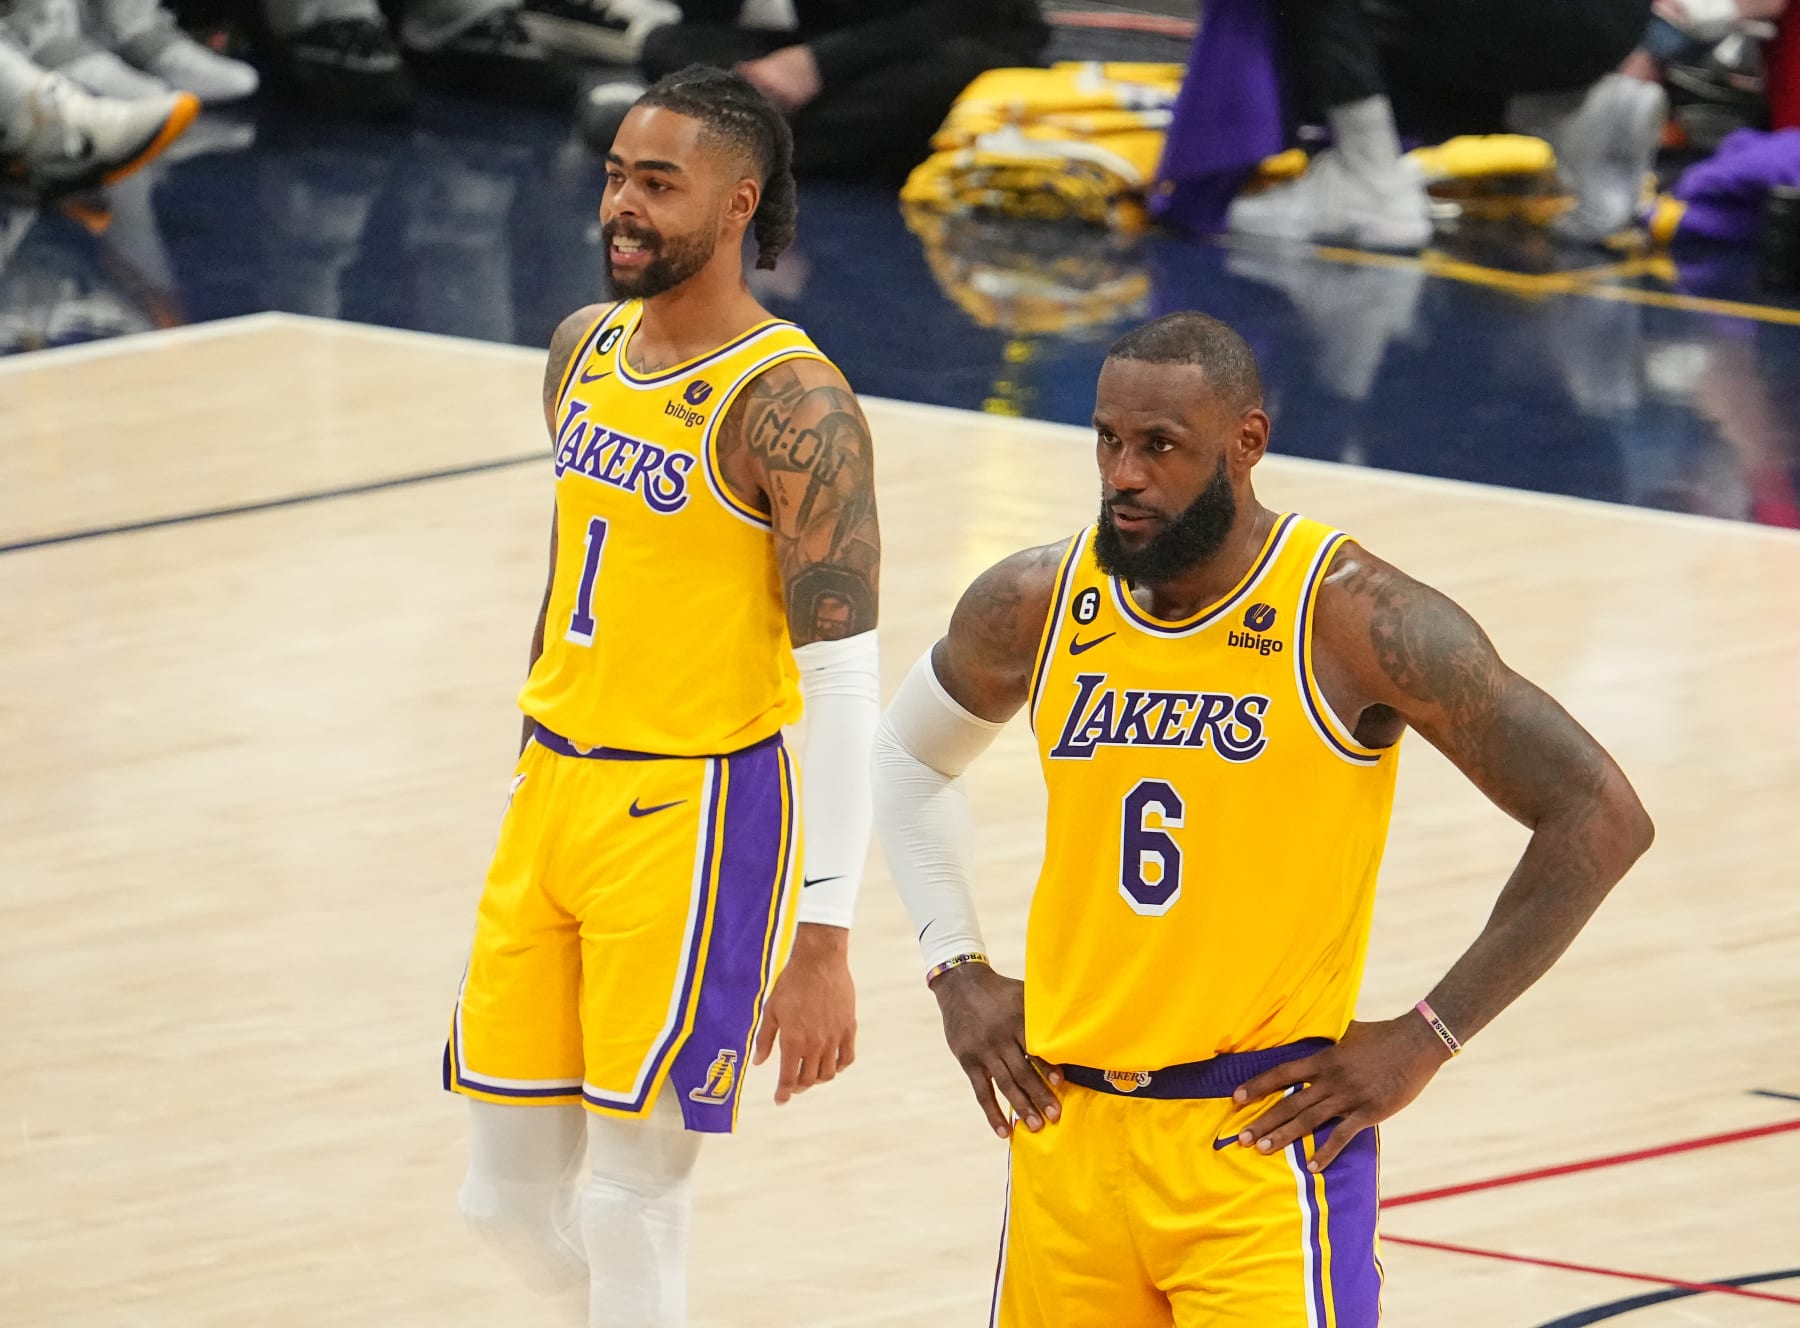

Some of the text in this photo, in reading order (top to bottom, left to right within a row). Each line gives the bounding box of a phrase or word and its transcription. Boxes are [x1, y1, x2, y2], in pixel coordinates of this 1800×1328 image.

[600, 327, 622, 353] 6
[664, 400, 705, 427] bibigo
[556, 401, 697, 514] LAKERS
[564, 516, 609, 647] 1
[1079, 592, 1096, 620] 6
[1227, 630, 1284, 656] bibigo
[1048, 672, 1272, 763] LAKERS
[1119, 777, 1185, 916] 6
